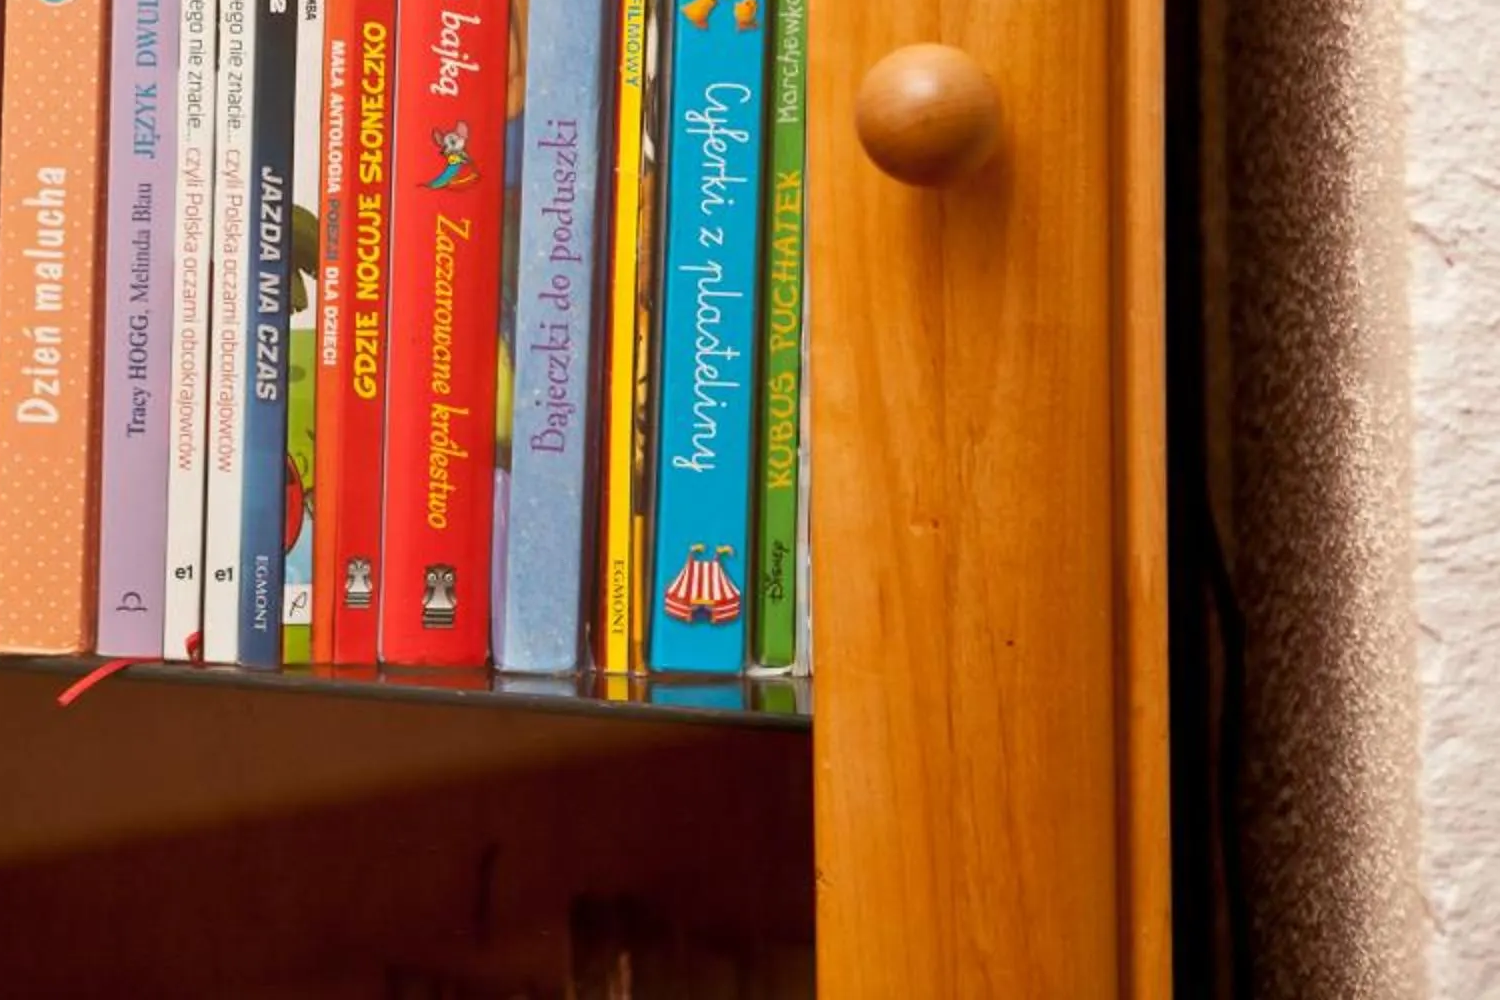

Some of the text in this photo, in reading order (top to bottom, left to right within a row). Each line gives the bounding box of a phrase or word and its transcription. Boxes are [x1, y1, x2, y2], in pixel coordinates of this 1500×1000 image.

[187, 40, 207, 66] nie
[228, 40, 247, 67] nie
[329, 40, 346, 88] MAŁA
[430, 10, 481, 97] bajką
[133, 83, 162, 159] JĘZYK
[327, 93, 345, 194] ANTOLOGIA
[182, 147, 205, 187] czyli
[221, 149, 243, 188] czyli
[183, 193, 203, 252] Polska
[222, 194, 243, 253] Polska
[353, 22, 388, 399] GDZIE NOCUJE SŁONECZKO
[15, 167, 67, 424] Dzień malucha
[182, 257, 201, 322] oczami
[221, 258, 241, 324] oczami
[256, 167, 284, 400] JAZDA NA CZAS
[324, 266, 340, 300] DLA
[530, 119, 583, 454] Bajeczki do poduszki
[672, 83, 752, 473] Cyferki z plasteliny
[769, 170, 802, 353] PUCHATEK
[127, 182, 153, 437] Tracy HOGG, Melinda Blau
[323, 306, 339, 365] DZIECI
[176, 328, 198, 471] obcokrajowców
[215, 330, 238, 472] obcokrajowców
[427, 215, 471, 529] Zaczarowane królestwo
[253, 555, 270, 632] EGMONT
[611, 559, 626, 636] EGMONT
